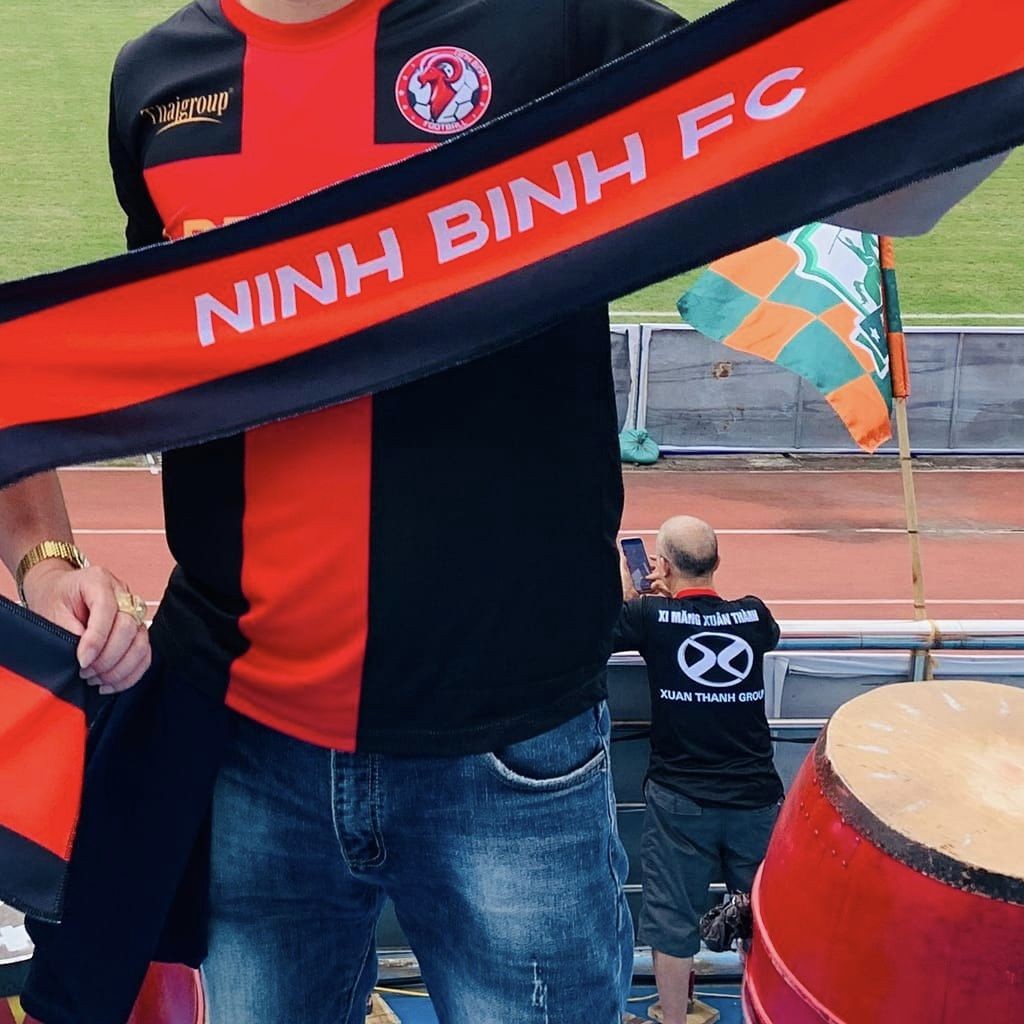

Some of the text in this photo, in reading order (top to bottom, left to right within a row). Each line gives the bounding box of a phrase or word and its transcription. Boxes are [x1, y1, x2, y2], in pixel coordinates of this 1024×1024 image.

[195, 66, 806, 347] NINH BINH FC
[658, 609, 669, 623] XI
[660, 689, 764, 702] XUAN THANH GROU
